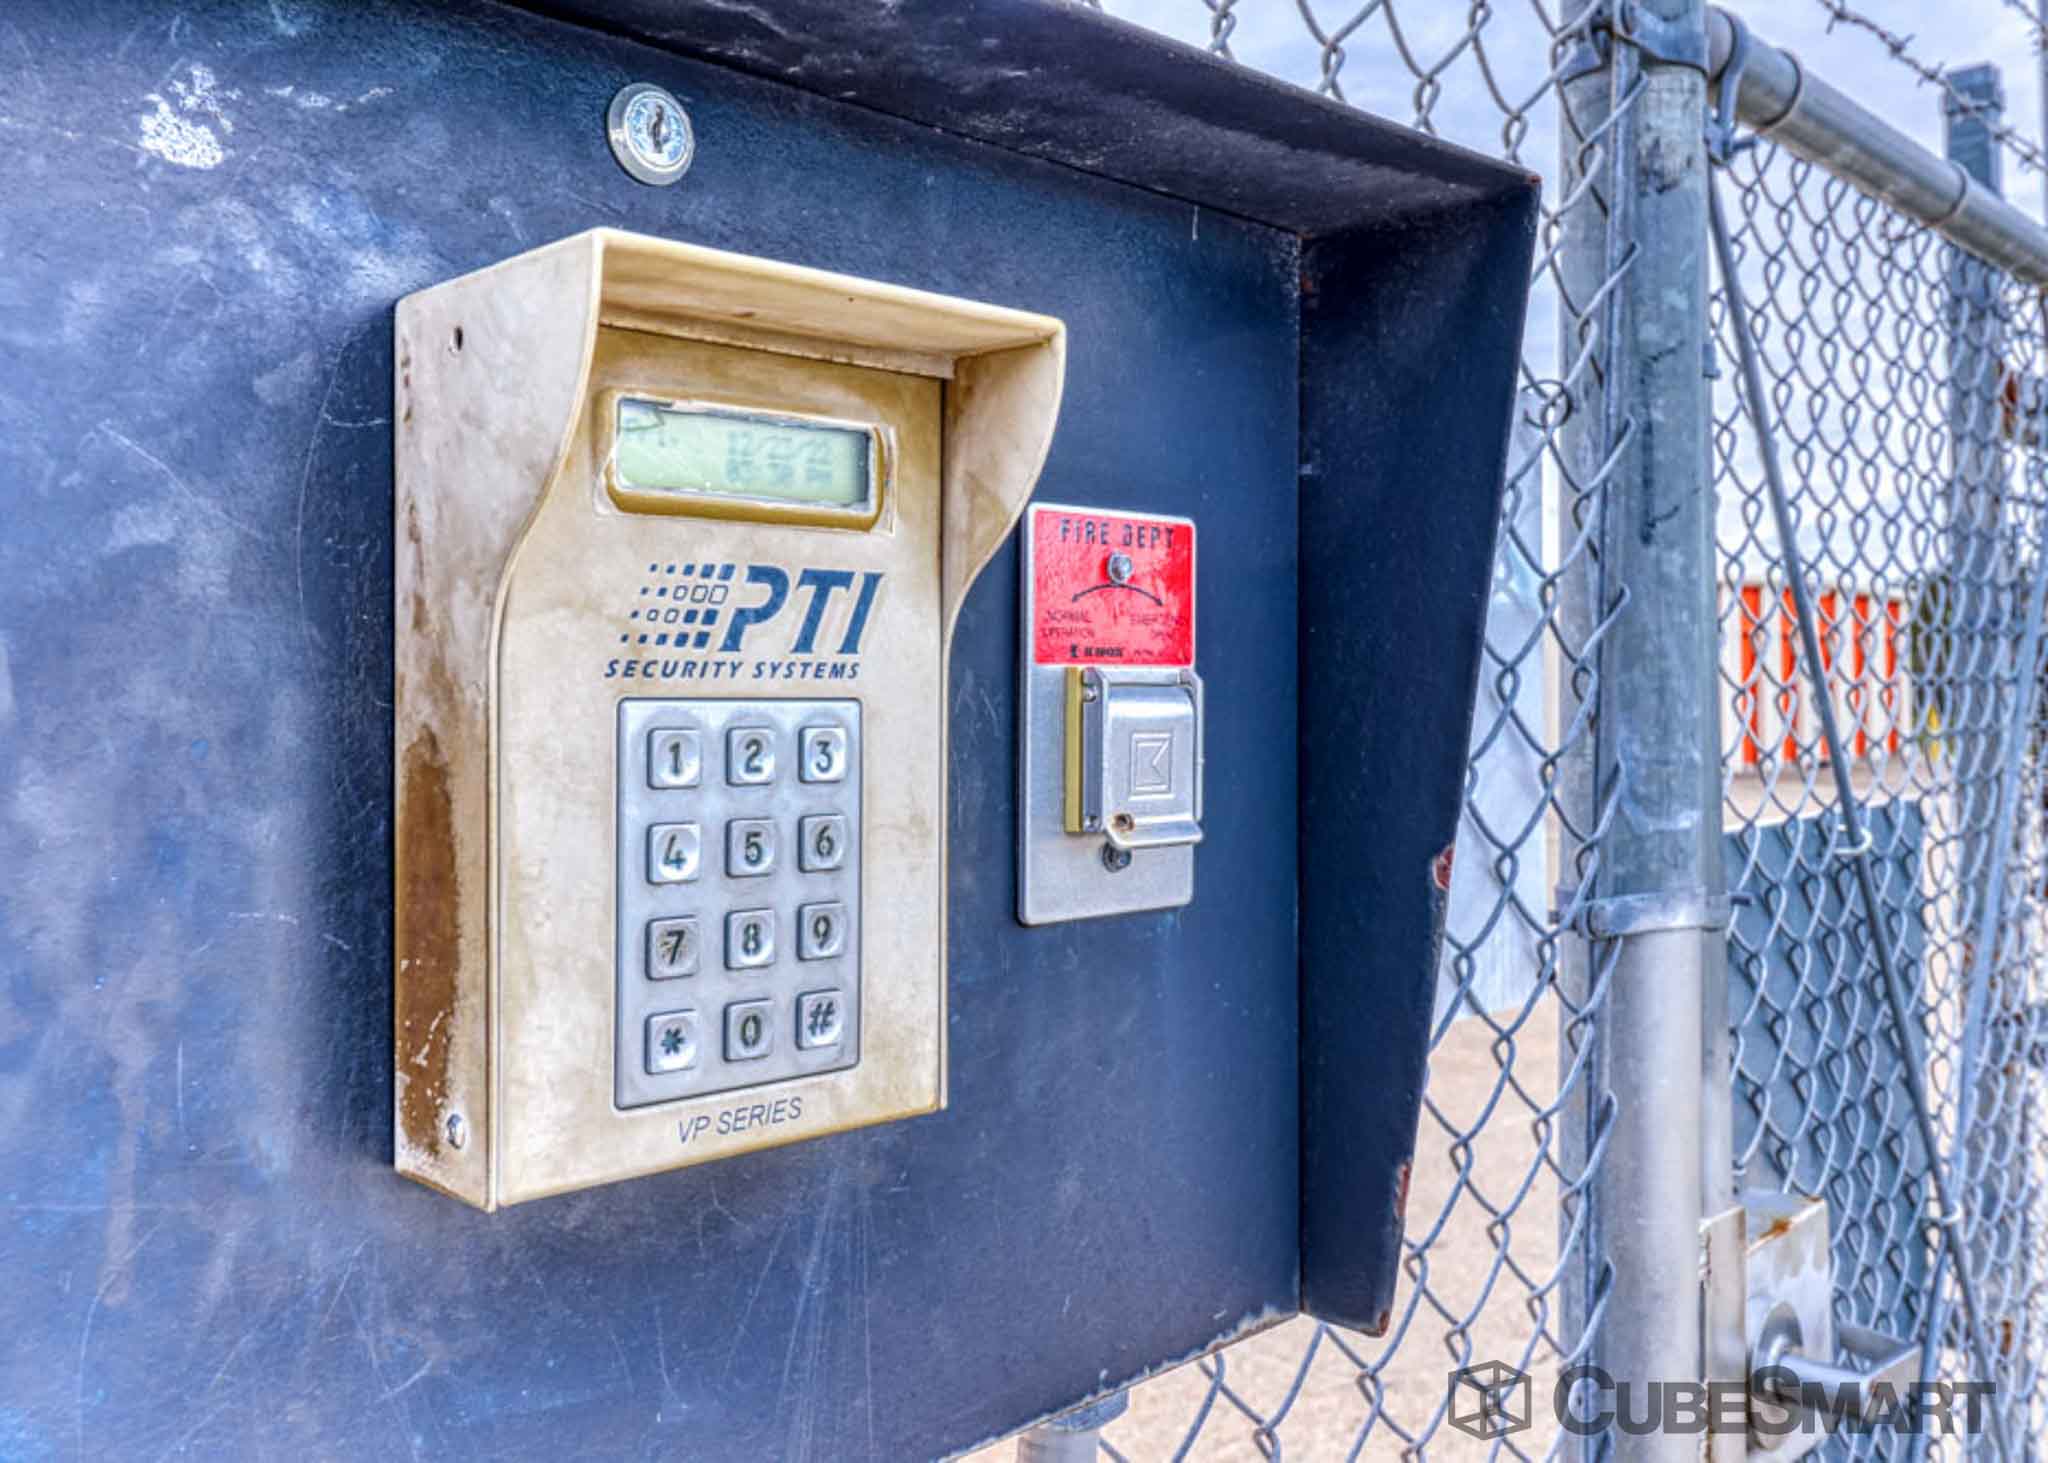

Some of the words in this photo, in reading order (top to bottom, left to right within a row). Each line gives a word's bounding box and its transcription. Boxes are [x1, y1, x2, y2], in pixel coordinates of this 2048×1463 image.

[1061, 518, 1110, 546] FIRE
[1122, 525, 1175, 550] DEPT
[718, 565, 885, 654] PTI
[604, 659, 743, 678] SECURITY
[752, 661, 861, 679] SYSTEMS
[668, 741, 682, 776] 1
[744, 738, 764, 774] 2
[814, 740, 834, 773] 3
[663, 833, 687, 870] 4
[744, 831, 763, 866] 5
[815, 824, 835, 858] 6
[665, 929, 685, 966] 7
[743, 922, 760, 956] 8
[812, 914, 832, 950] 9
[740, 1014, 762, 1048] 0
[808, 1001, 836, 1036] #
[677, 1115, 711, 1144] VP
[716, 1096, 803, 1135] SERIES
